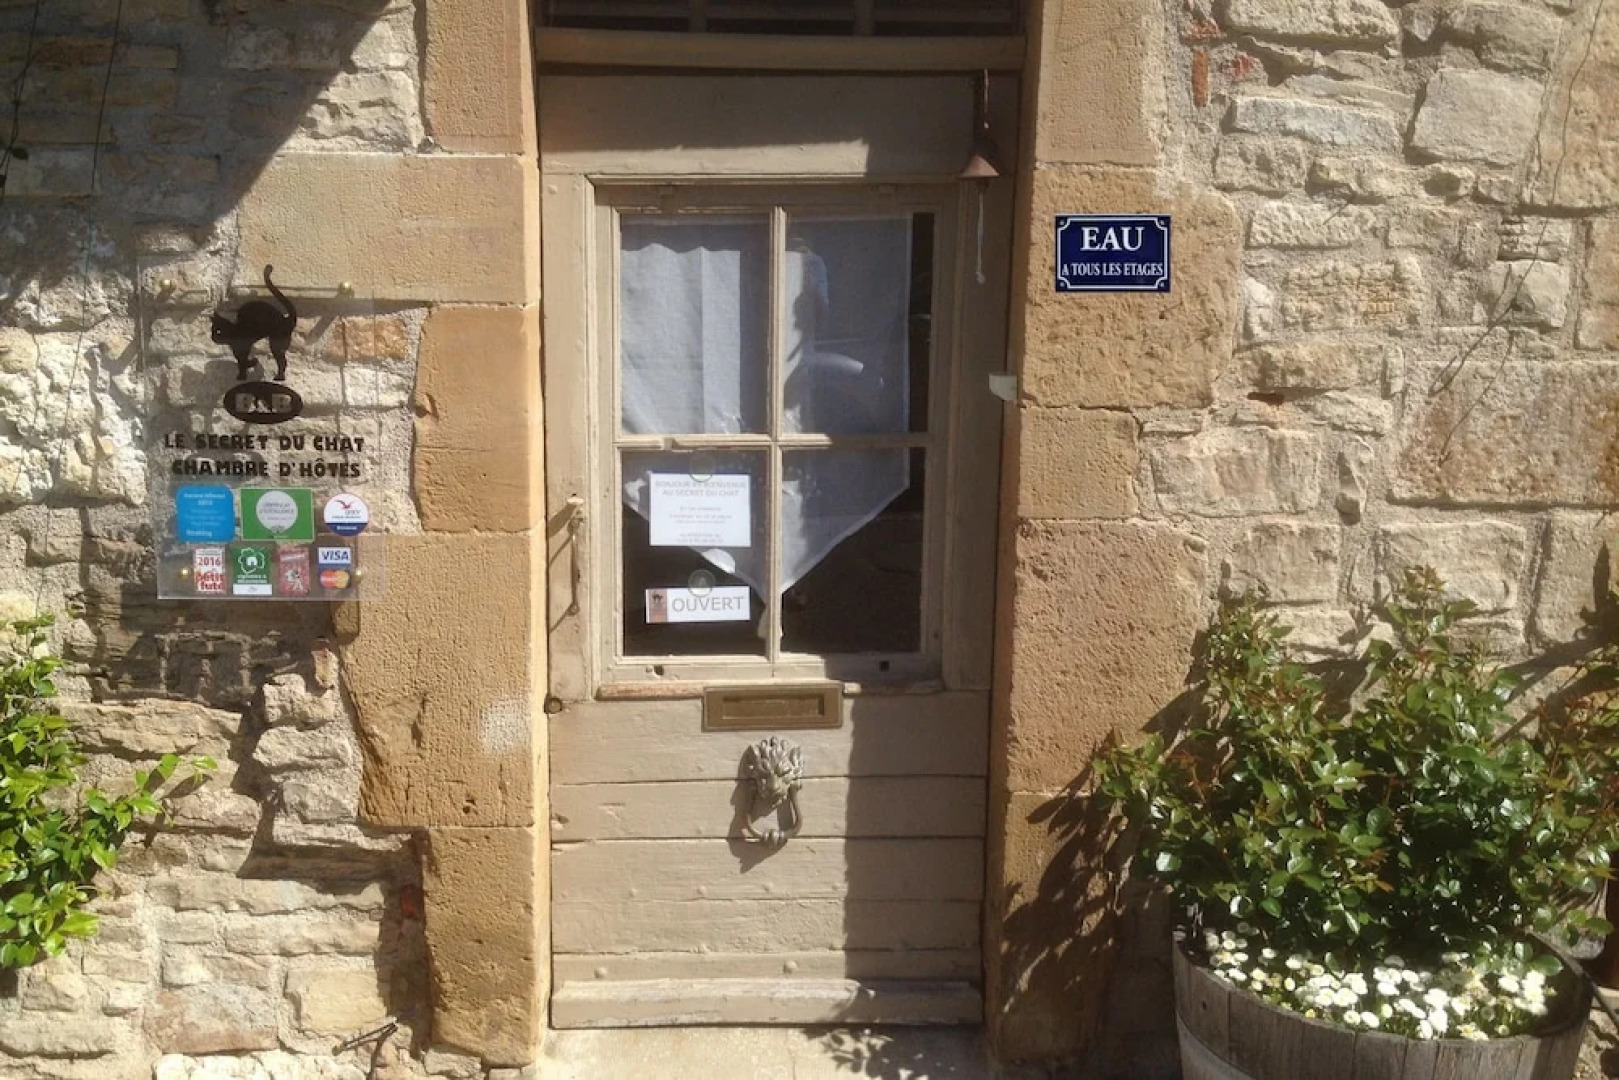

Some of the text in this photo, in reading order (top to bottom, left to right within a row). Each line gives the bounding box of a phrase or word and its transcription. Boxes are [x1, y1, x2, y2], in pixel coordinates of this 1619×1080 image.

[1080, 226, 1145, 251] EAU
[1061, 263, 1163, 276] A TOUS LES ETAGES
[236, 392, 292, 414] B&B
[165, 433, 365, 452] LE SECRET DU CHAT
[172, 458, 360, 477] CHAMBRE D'HÔTES
[198, 556, 221, 566] 2016
[322, 550, 349, 560] VISA
[672, 595, 745, 613] OUVERT
